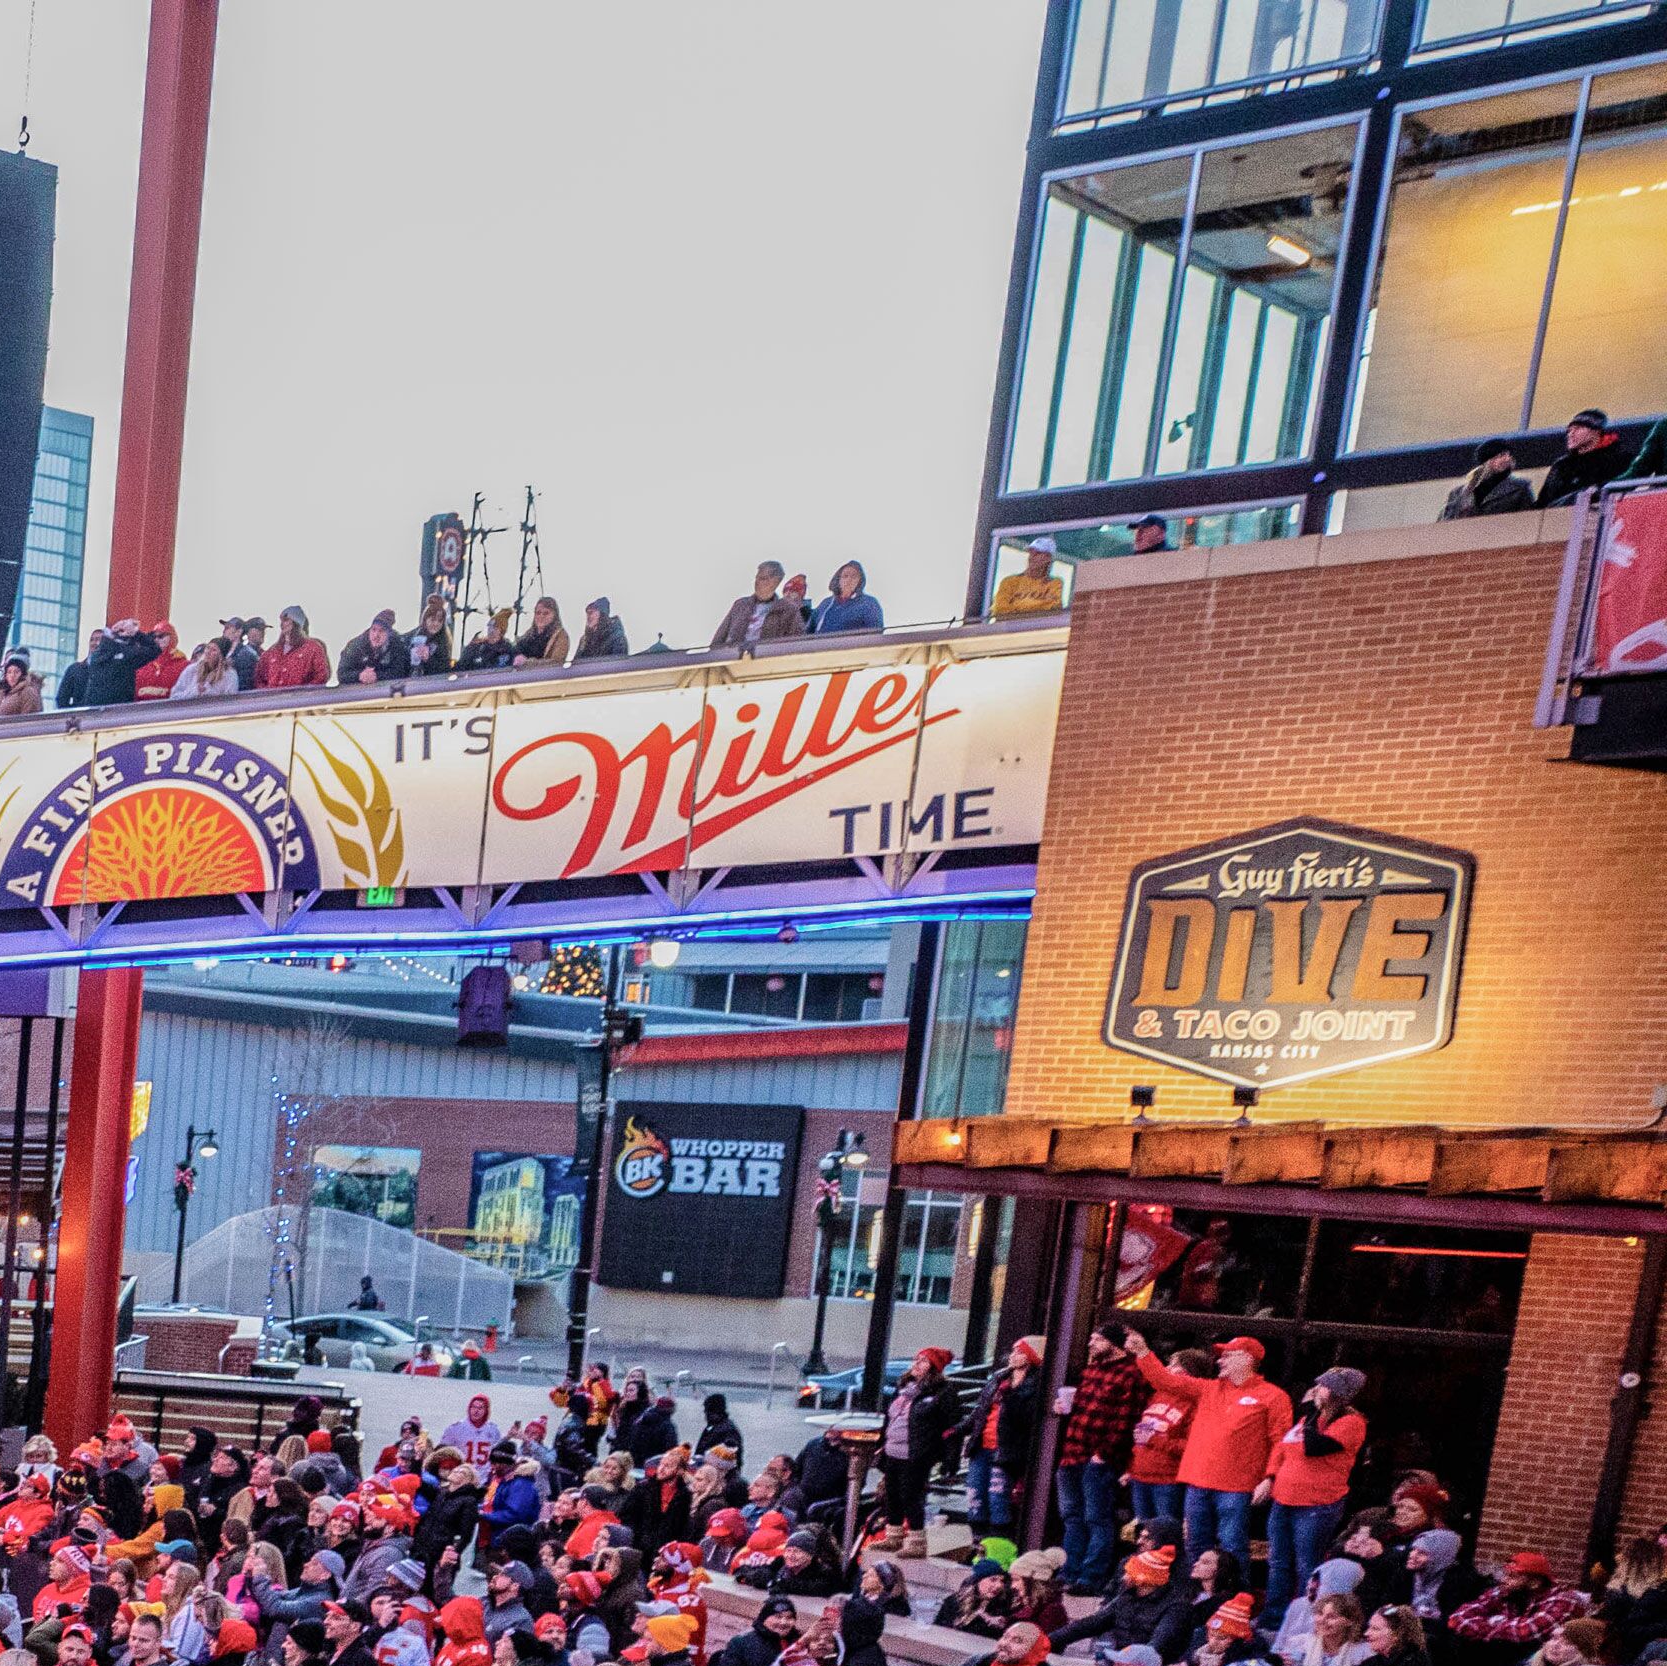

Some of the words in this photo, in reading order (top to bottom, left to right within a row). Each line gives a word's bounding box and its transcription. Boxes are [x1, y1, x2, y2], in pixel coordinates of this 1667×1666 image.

[395, 716, 494, 763] IT'S
[493, 661, 967, 880] Miller
[22, 756, 124, 856] FINE
[143, 734, 305, 867] PILSNER
[829, 788, 994, 854] TIME
[6, 873, 44, 902] A
[1218, 854, 1284, 898] Guy
[1287, 851, 1374, 896] Fieri's
[1132, 893, 1446, 1007] DIVE
[1133, 1010, 1163, 1040] &
[1175, 1009, 1280, 1041] TACO
[1292, 1009, 1417, 1042] JOINT
[1209, 1043, 1274, 1059] KANSAS
[1280, 1043, 1320, 1059] CITY
[626, 1153, 665, 1180] BK
[671, 1139, 786, 1160] WHOPPER
[668, 1159, 781, 1197] BAR
[466, 1441, 490, 1467] 15
